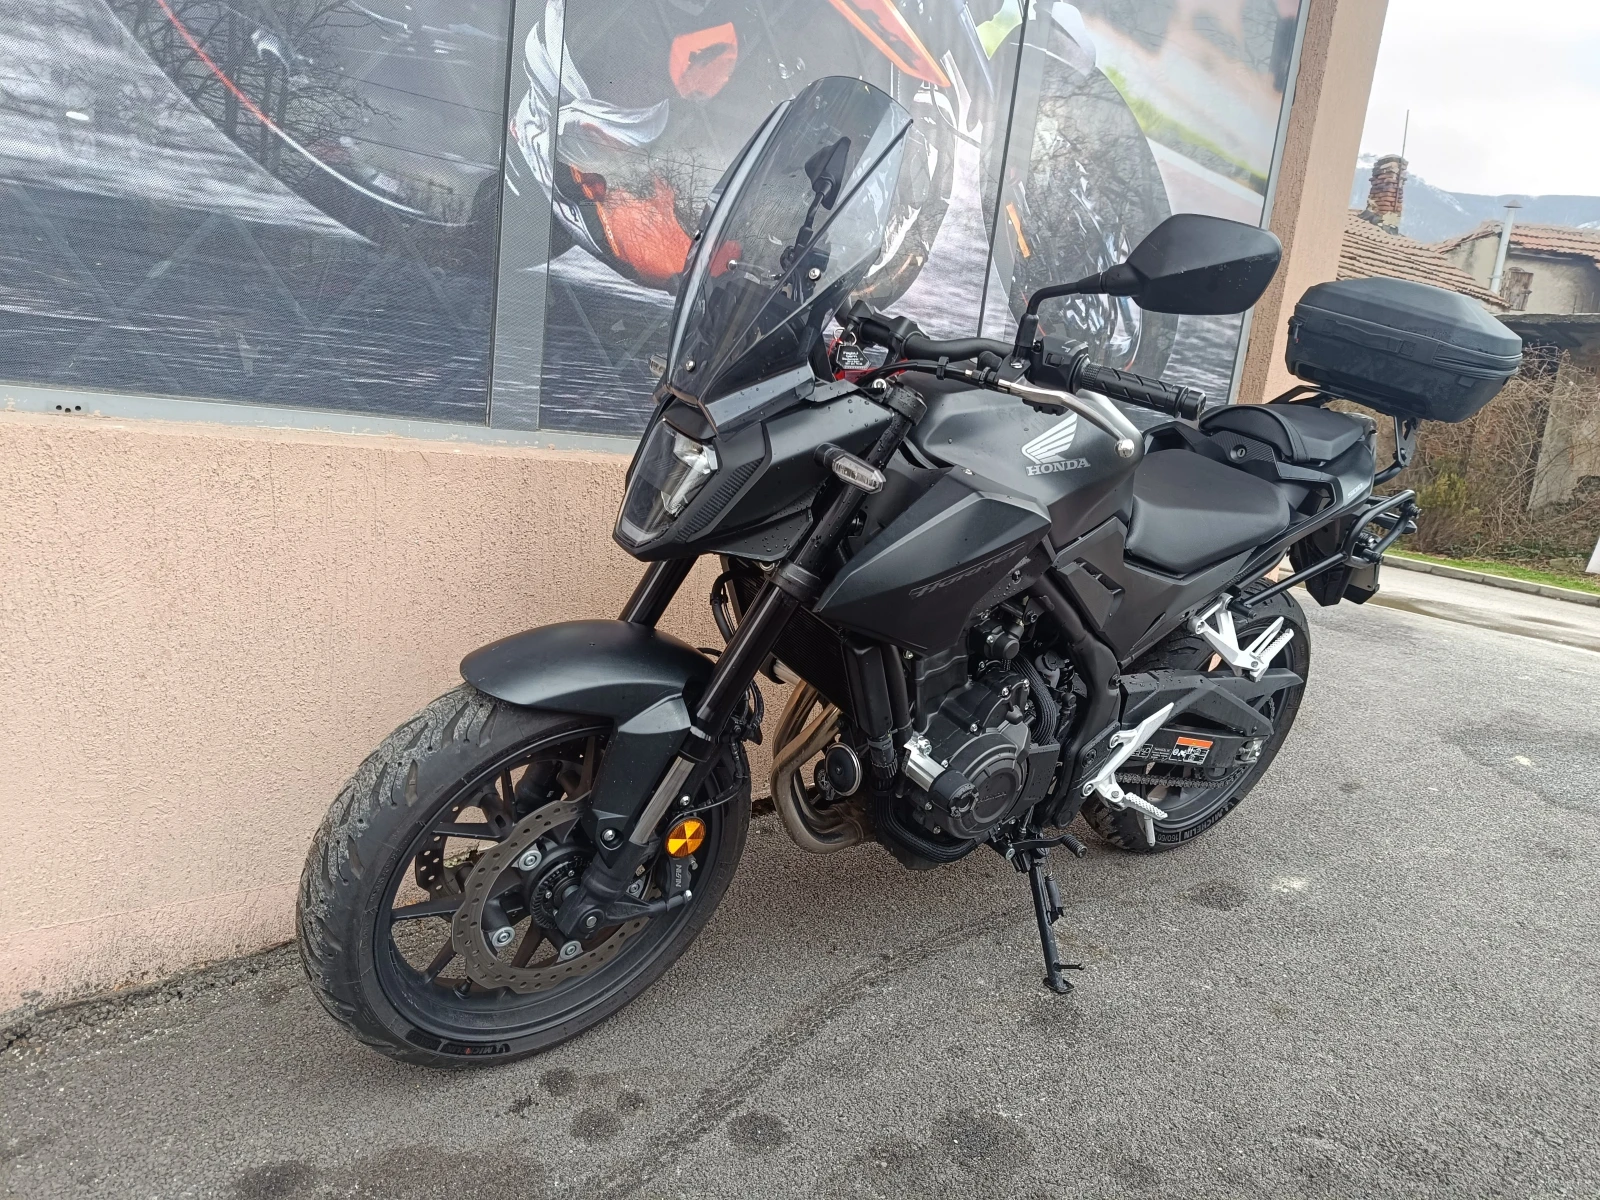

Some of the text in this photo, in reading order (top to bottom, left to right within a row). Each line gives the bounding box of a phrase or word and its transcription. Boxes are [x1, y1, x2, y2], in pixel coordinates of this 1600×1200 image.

[1025, 457, 1091, 476] HONDA
[1183, 811, 1224, 840] MICHELIN
[1157, 833, 1179, 842] 160/60
